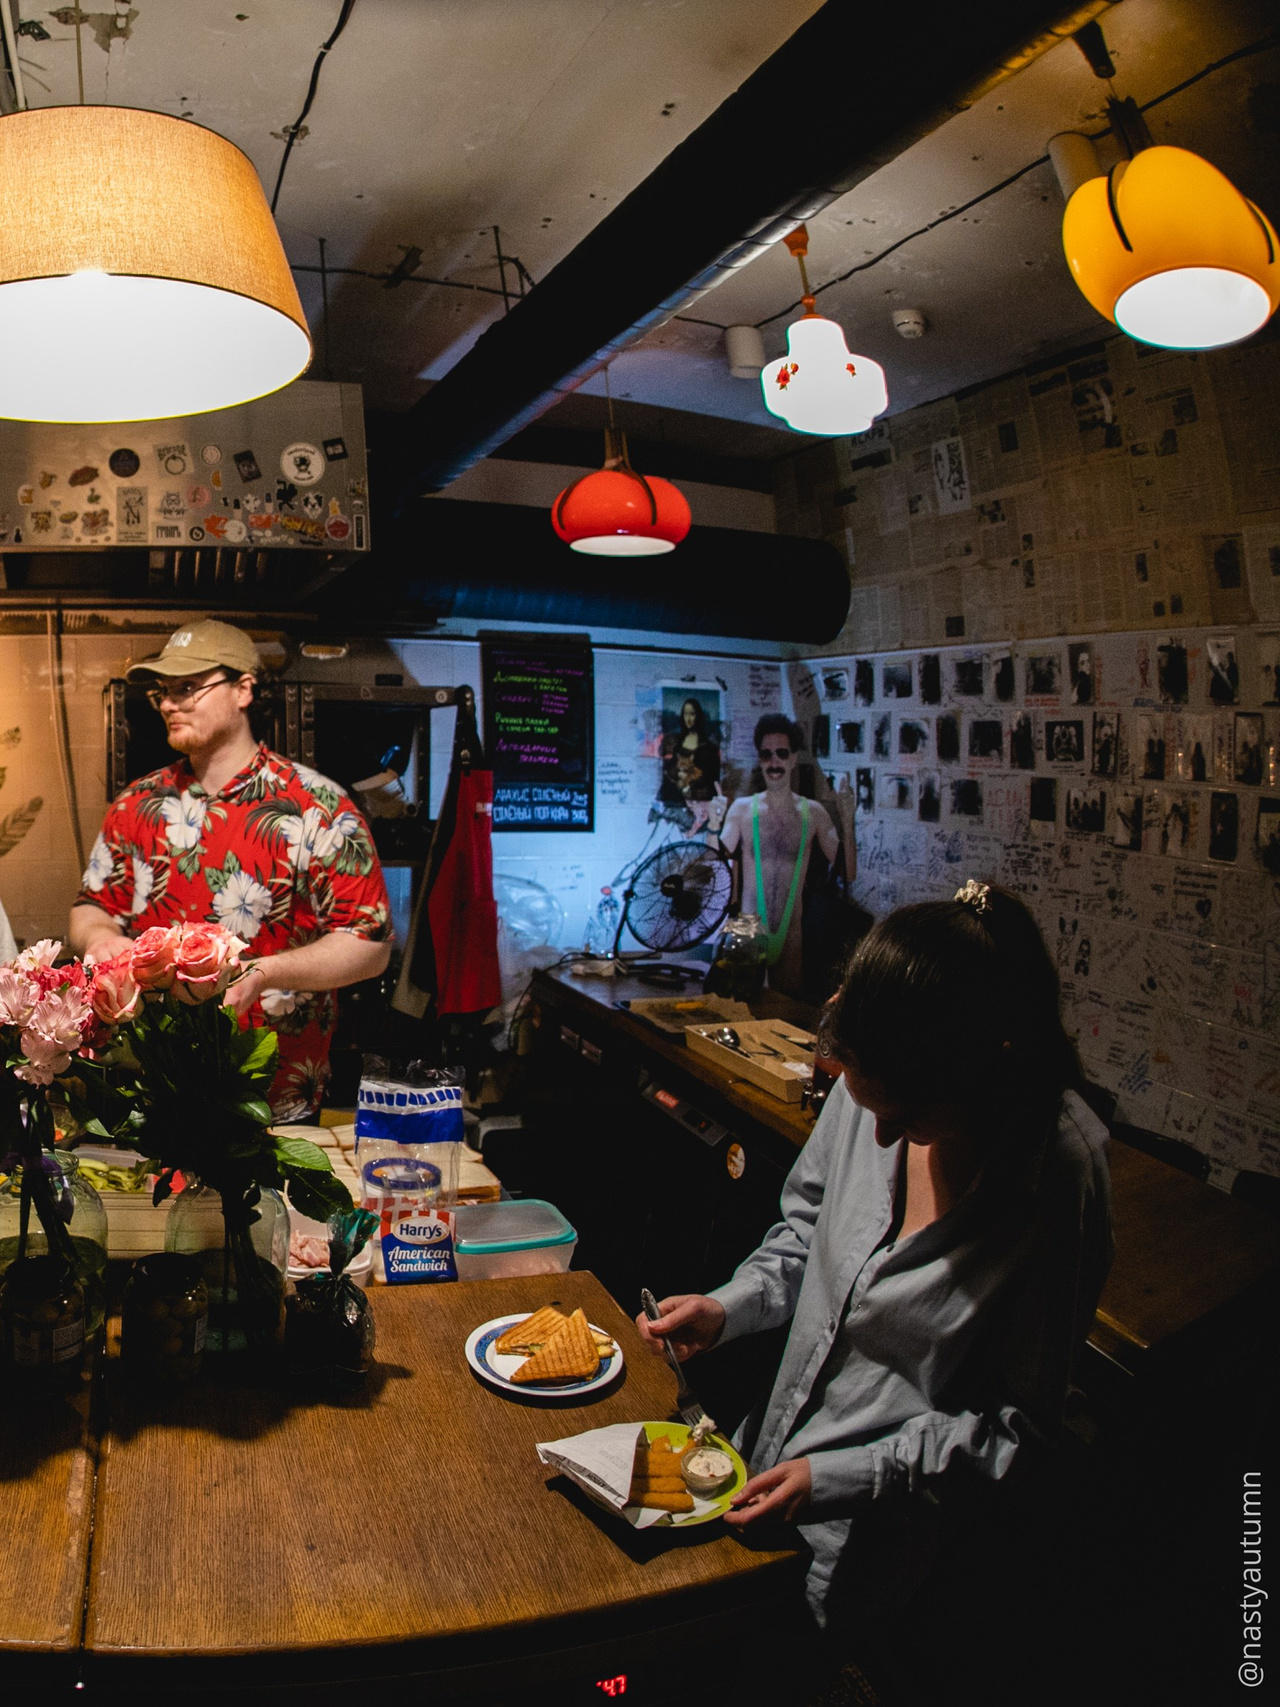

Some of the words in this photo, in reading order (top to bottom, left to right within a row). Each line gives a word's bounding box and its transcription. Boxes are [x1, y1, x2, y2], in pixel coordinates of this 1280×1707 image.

[399, 1223, 442, 1239] Harry's
[388, 1245, 450, 1261] American
[390, 1260, 448, 1273] Sandwich
